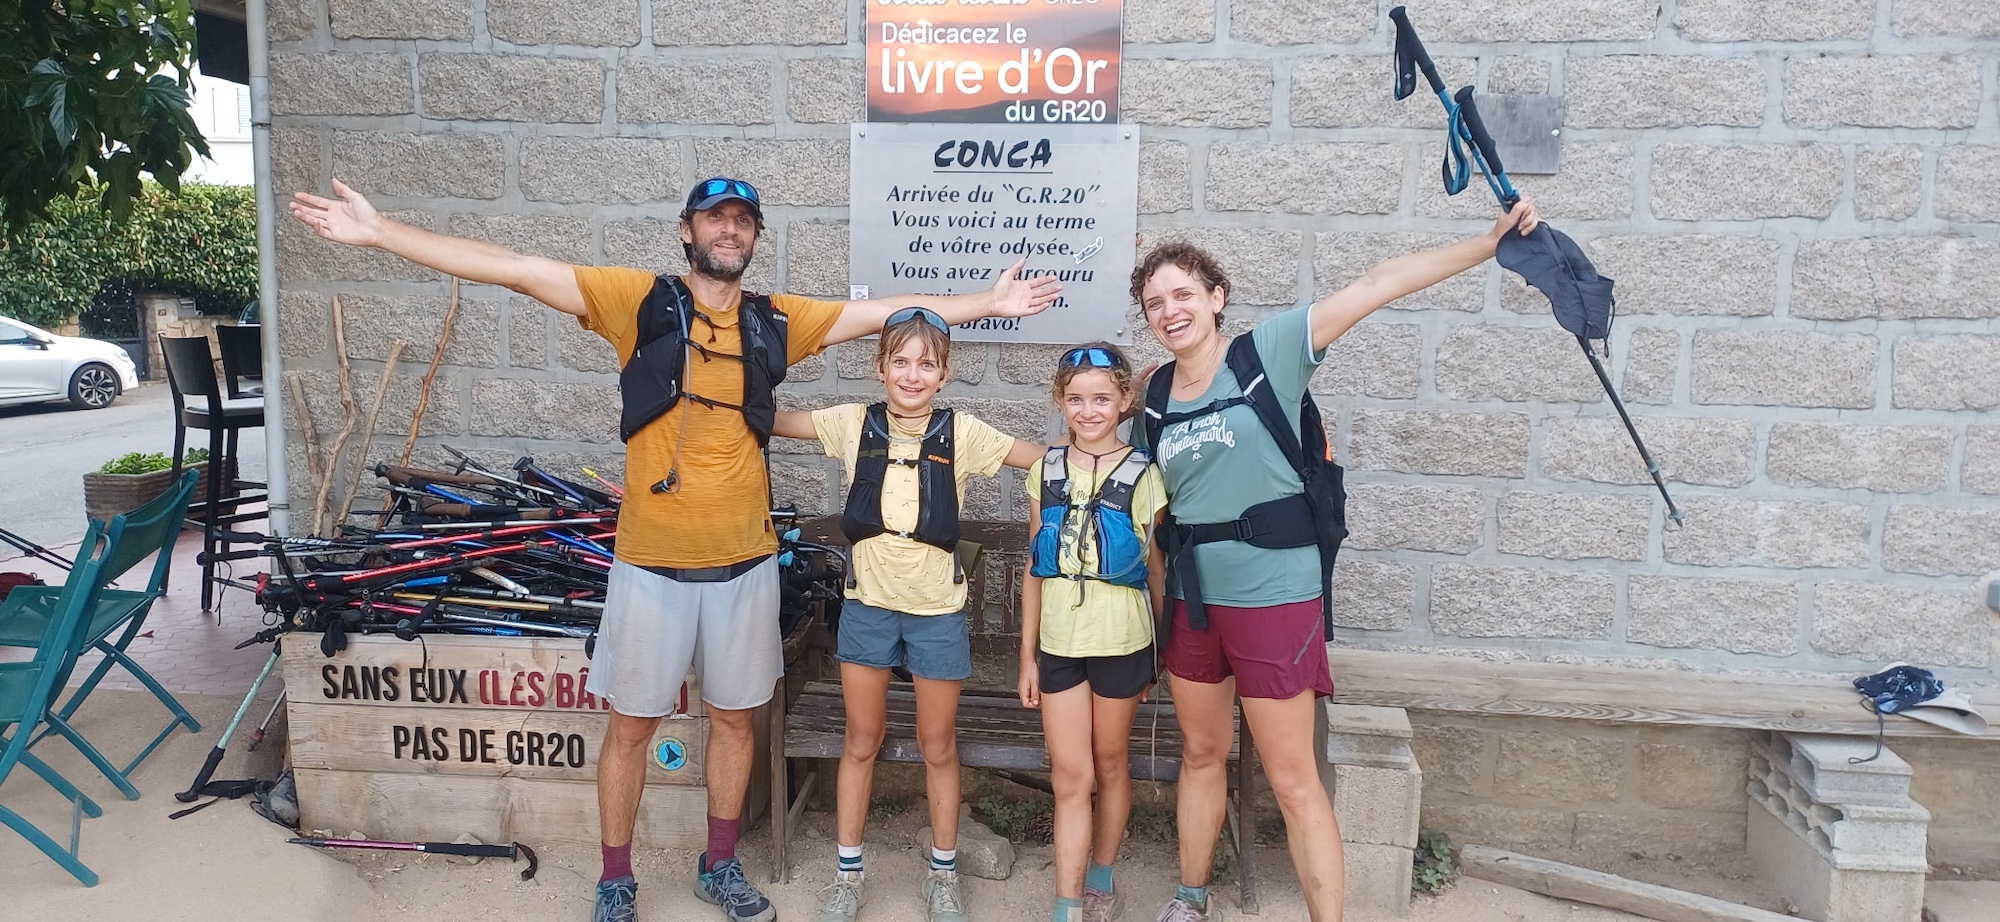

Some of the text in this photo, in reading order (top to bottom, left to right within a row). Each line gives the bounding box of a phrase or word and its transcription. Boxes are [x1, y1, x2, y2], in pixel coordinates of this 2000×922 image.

[882, 21, 1027, 44] Dédicacez le
[881, 47, 1108, 94] livre d'Or
[1005, 100, 1107, 122] du GR20
[933, 138, 1052, 169] CONCA
[887, 185, 960, 202] Arrivée
[967, 185, 993, 203] du
[892, 211, 1095, 230] Vous voici au terme
[909, 235, 1074, 259] de vôtre odysée.
[891, 262, 938, 279] Vous
[946, 267, 991, 280] avez
[1157, 417, 1236, 472] Montagnarde
[322, 665, 399, 701] SANS
[409, 668, 469, 703] EUX
[479, 670, 545, 707] (LES
[393, 725, 585, 768] PAS DE GR20
